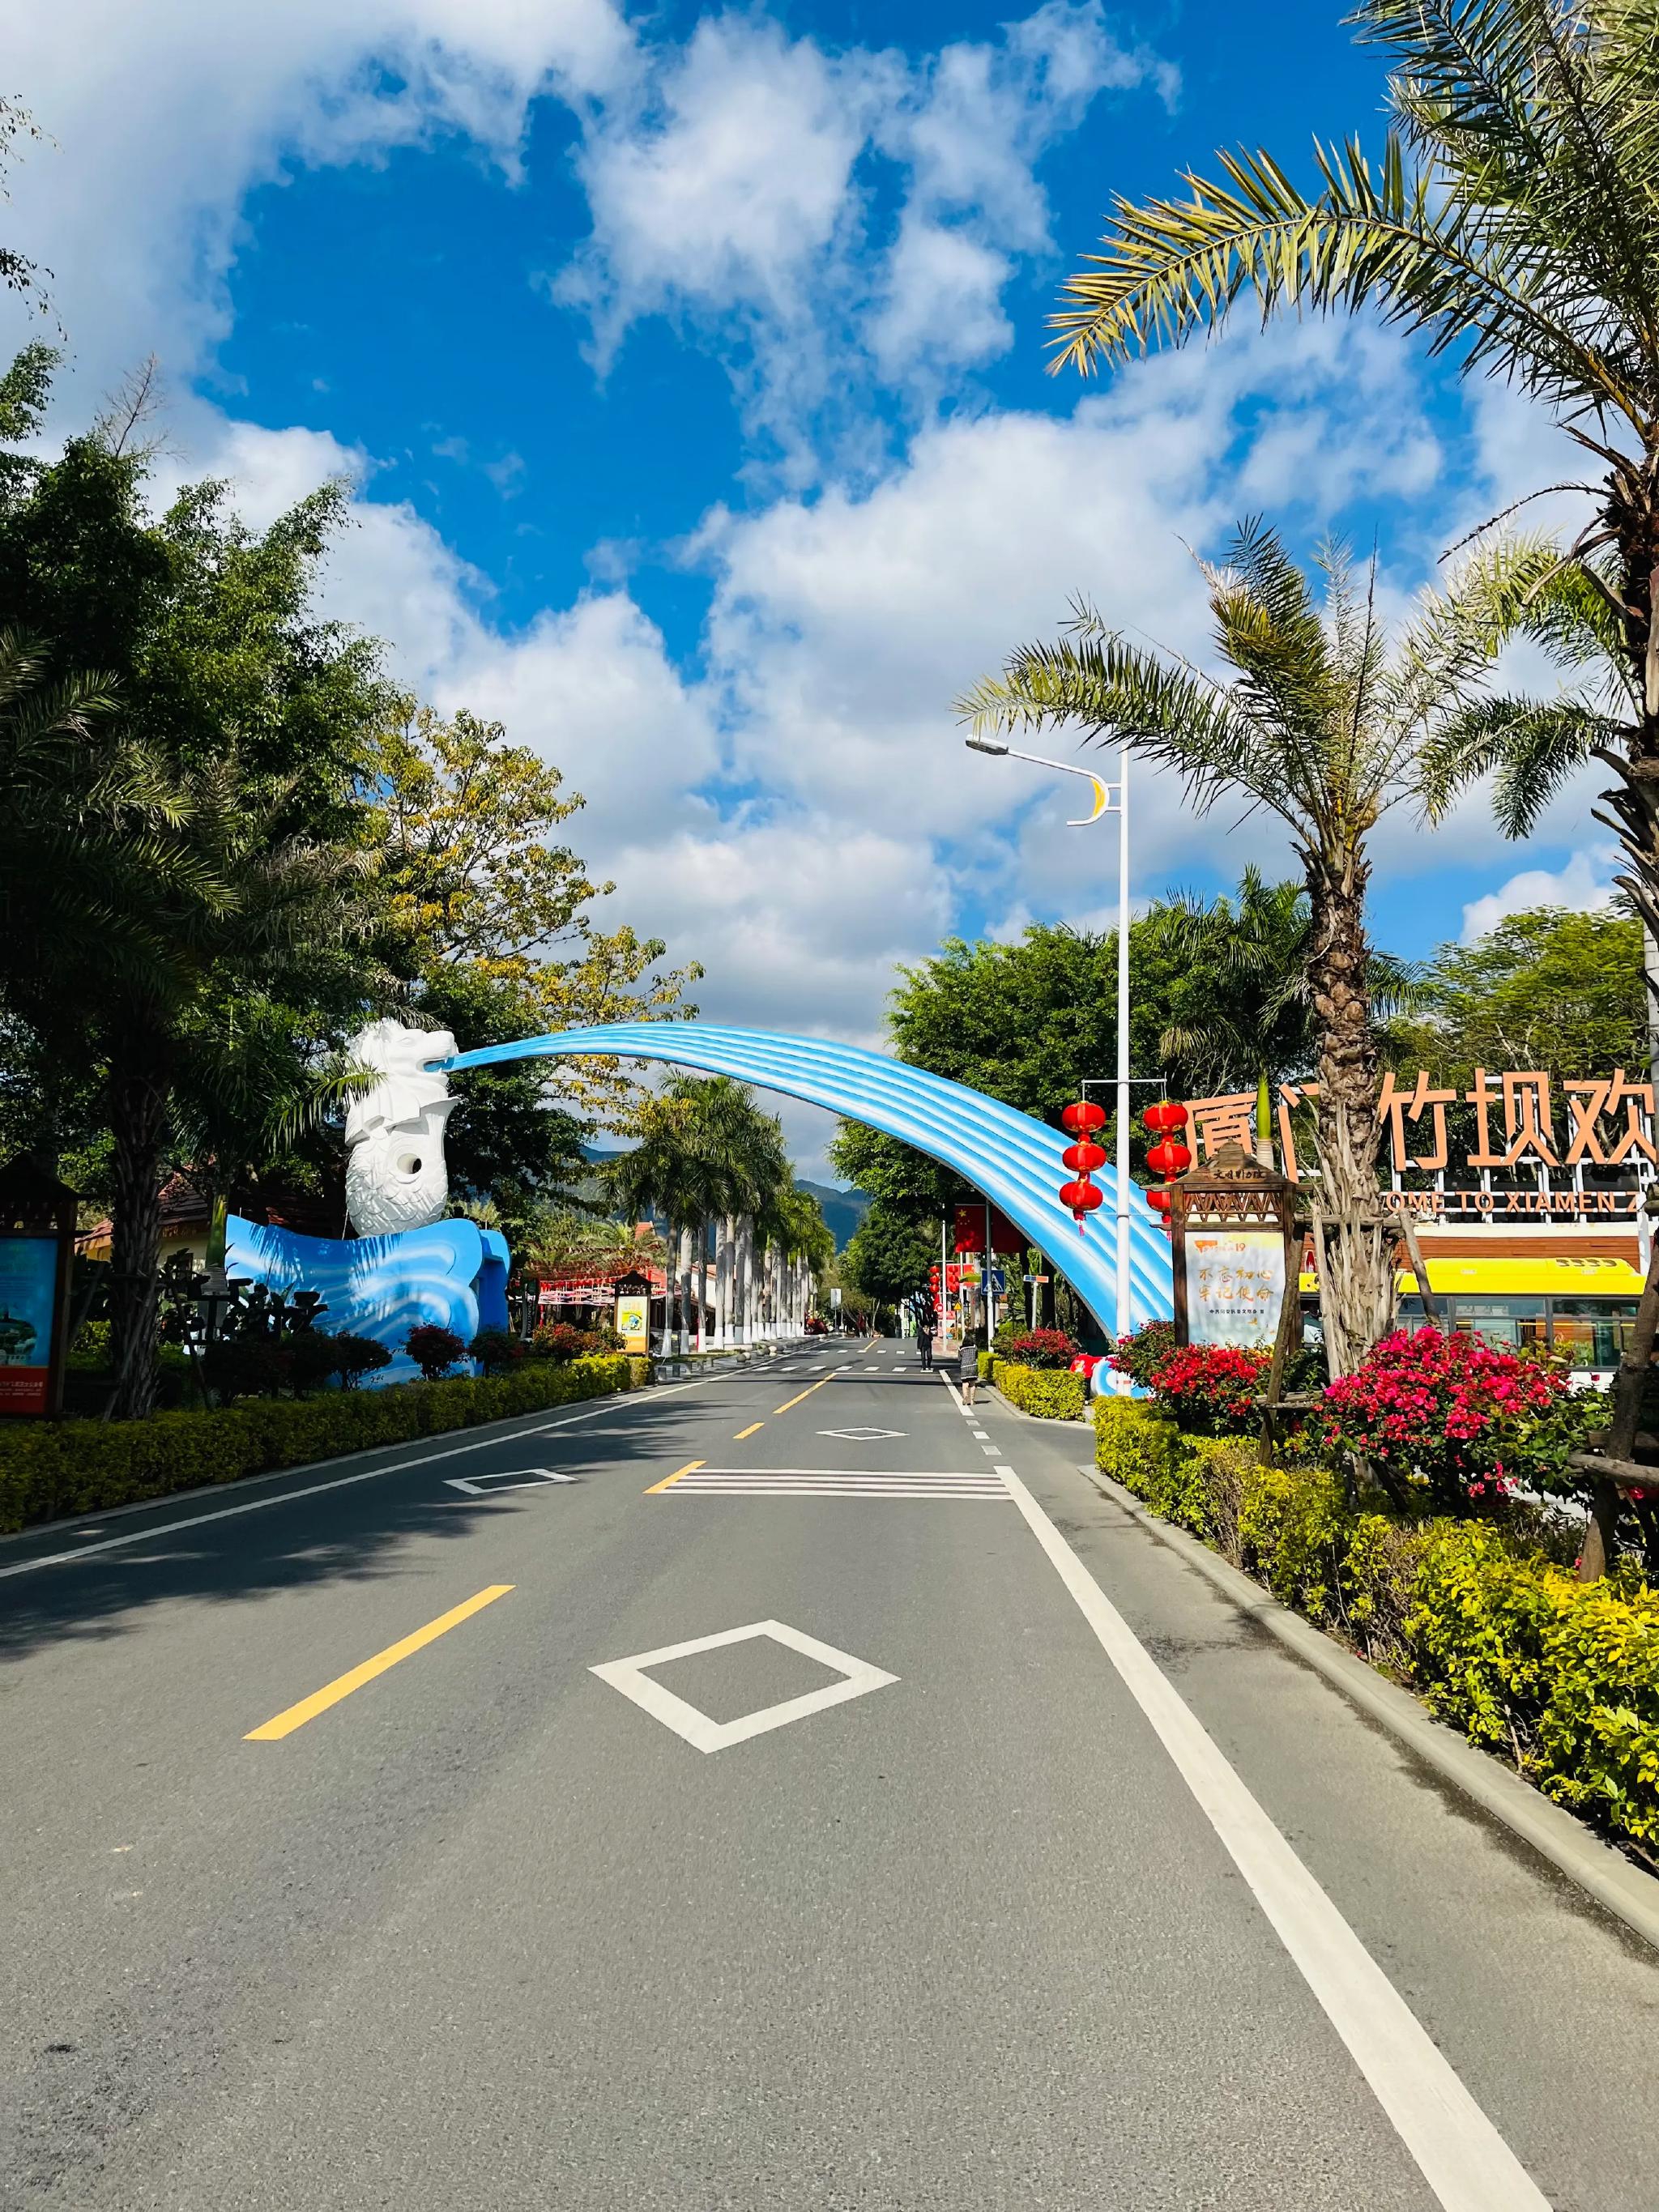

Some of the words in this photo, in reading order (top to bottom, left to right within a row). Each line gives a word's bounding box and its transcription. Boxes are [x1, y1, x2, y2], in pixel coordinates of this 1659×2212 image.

[1456, 1191, 1495, 1213] TO
[1505, 1191, 1615, 1213] XIAMEN
[1199, 1266, 1273, 1282] 不忘初心
